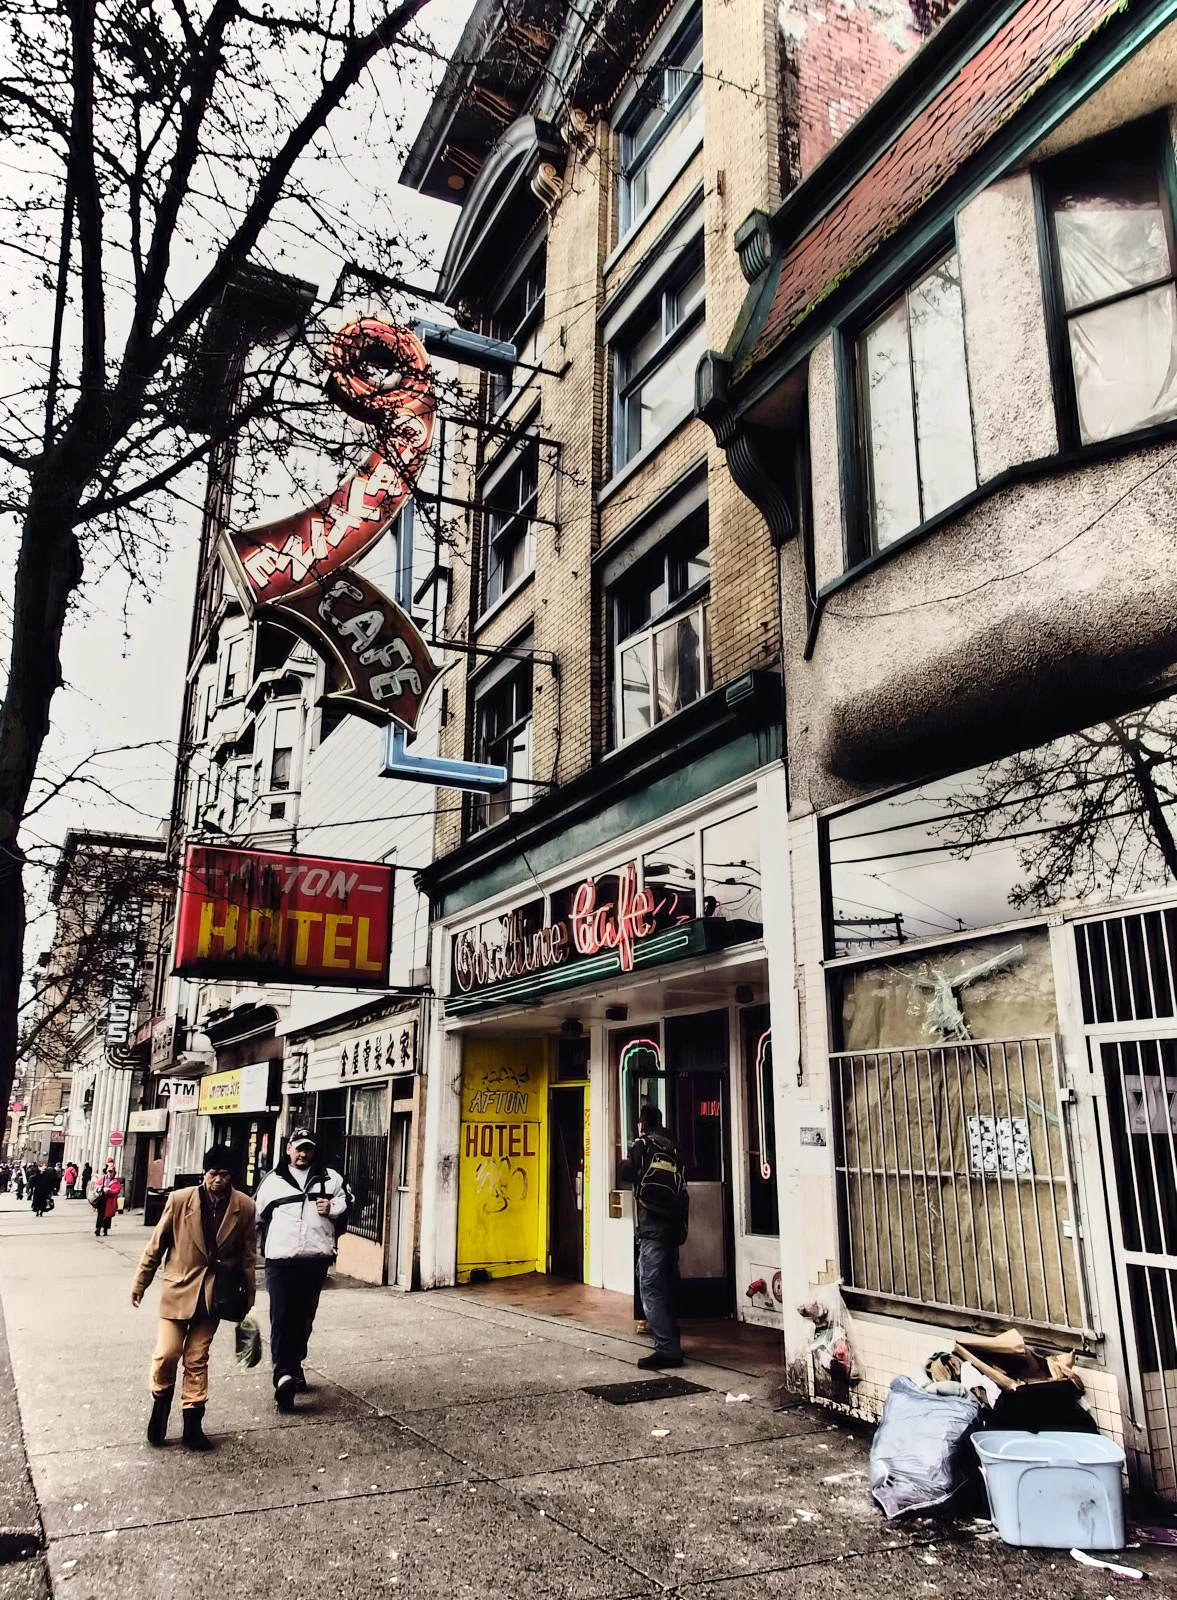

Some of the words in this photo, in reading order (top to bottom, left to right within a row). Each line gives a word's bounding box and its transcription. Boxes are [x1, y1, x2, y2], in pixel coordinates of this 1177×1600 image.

[318, 580, 422, 700] CAFE
[196, 902, 383, 971] HOTEL
[568, 861, 655, 971] Cafe
[160, 1082, 195, 1095] ATM
[469, 1090, 528, 1114] AFTON
[465, 1124, 536, 1157] HOTEL
